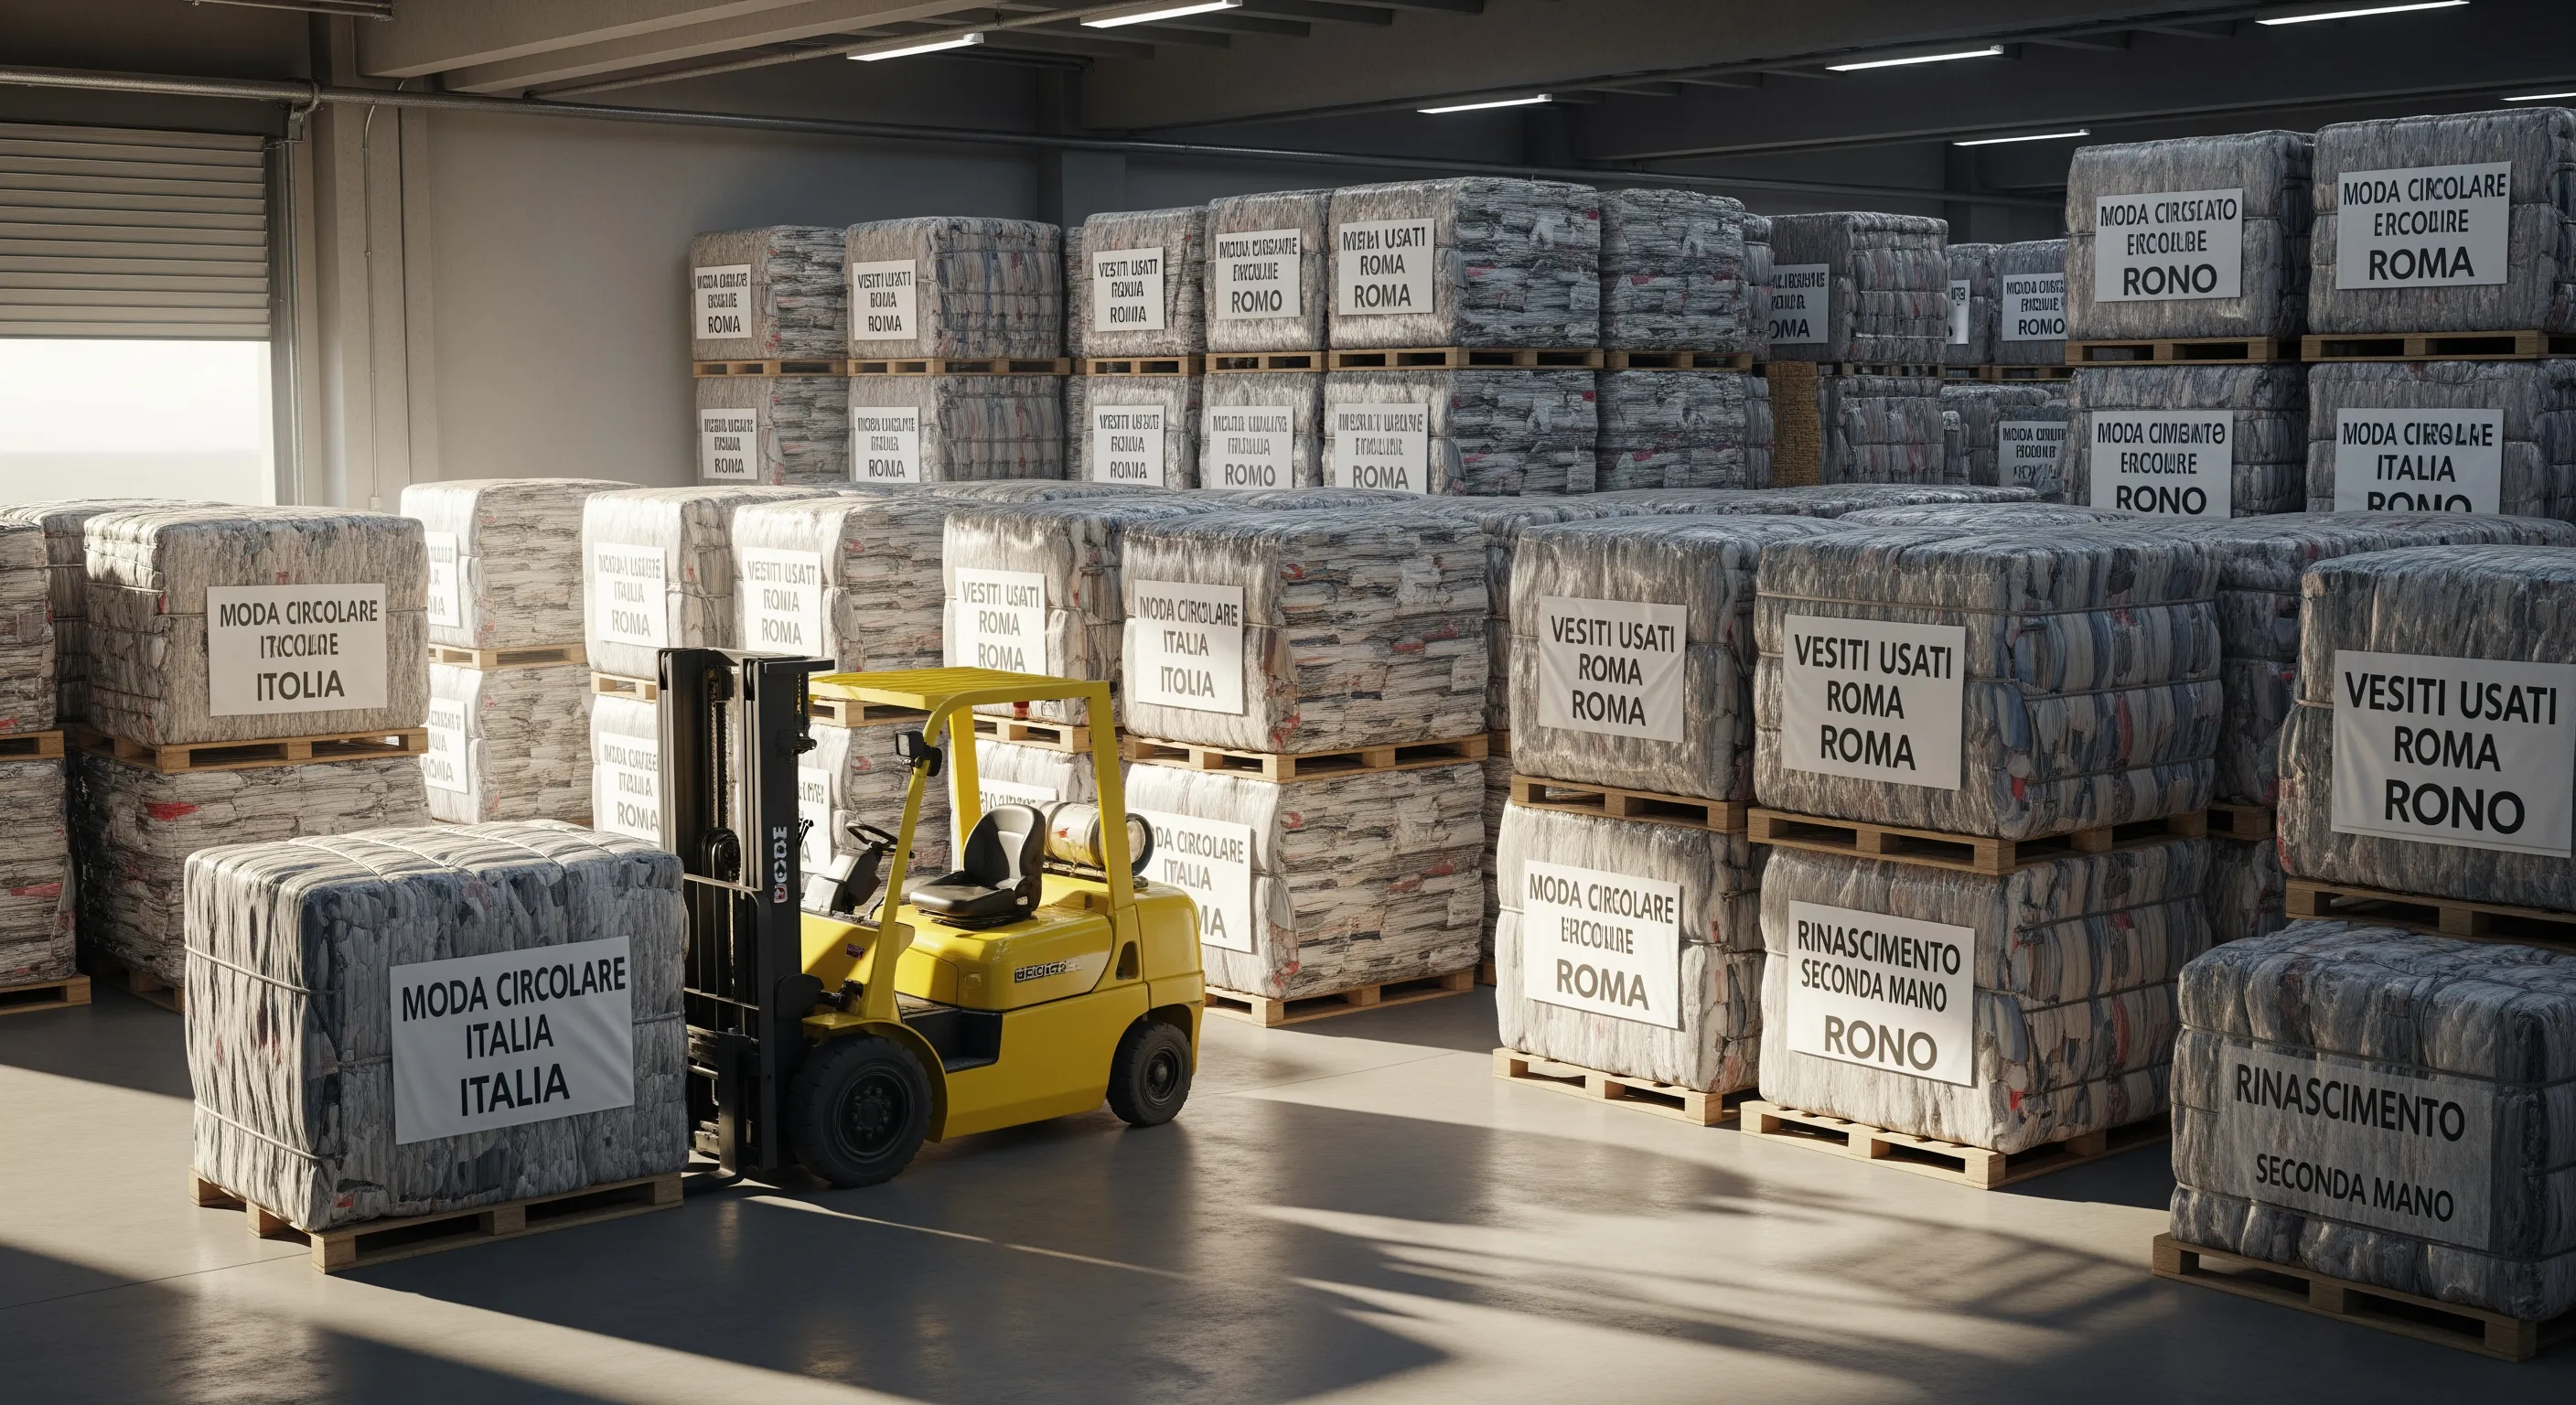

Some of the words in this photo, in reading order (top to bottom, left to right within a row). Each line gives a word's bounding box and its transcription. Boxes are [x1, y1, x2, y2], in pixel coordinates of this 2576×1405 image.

[2344, 180, 2401, 206] MODA
[2408, 173, 2506, 201] CIRCOLARE
[2100, 203, 2150, 227] MODA
[1360, 254, 1405, 275] ROMA
[2123, 263, 2217, 296] RONO
[2368, 246, 2475, 281] ROMA
[1232, 290, 1283, 313] ROMO
[1354, 284, 1411, 308] ROMA
[1769, 319, 1810, 339] OMA
[2018, 318, 2065, 335] ROMO
[2098, 423, 2144, 444] MODA
[2342, 423, 2398, 445] MODA
[1225, 464, 1276, 487] ROMO
[1353, 466, 1410, 489] ROMA
[2377, 454, 2456, 482] ITALIA
[2116, 485, 2207, 515] RONO
[1006, 584, 1039, 608] USATI
[220, 602, 281, 627] MODA
[285, 599, 378, 625] CIRCOLARE
[979, 610, 1021, 636] ROMA
[762, 617, 802, 646] ROMA
[1164, 629, 1209, 656] ITALIA
[1551, 616, 1612, 647] VESITI
[1619, 621, 1674, 652] USATI
[978, 642, 1025, 668] ROMA
[1579, 653, 1643, 686] ROMA
[1794, 634, 1869, 671] VESITI
[1880, 641, 1951, 679] USATI
[257, 670, 345, 702] ITOLIA
[1161, 666, 1215, 698] ITOLIA
[2345, 671, 2446, 716] VESITI
[2460, 681, 2557, 725] USATI
[1572, 690, 1646, 726] ROMA
[1827, 680, 1905, 719] ROMA
[1820, 724, 1916, 771] ROMA
[2394, 725, 2502, 772] ROMA
[617, 801, 659, 832] ROMA
[2385, 778, 2525, 835] RONO
[1155, 826, 1174, 852] DA
[1176, 831, 1244, 863] CIRCOLARE
[1164, 858, 1212, 892] ITALIA
[1530, 873, 1582, 908] MODA
[1588, 884, 1674, 925] CIRCOLARE
[1199, 905, 1227, 939] MA
[1798, 919, 1960, 975] RINASCIMENTO
[402, 976, 488, 1022] MODA
[497, 956, 626, 1007] CIRCOLARE
[1557, 958, 1649, 1011] ROMA
[1801, 958, 1884, 1002] SECONDA
[1889, 974, 1947, 1013] MANO
[467, 1014, 554, 1059] ITALIA
[1824, 1014, 1937, 1071] RONO
[460, 1063, 571, 1117] ITALIA
[2237, 1063, 2465, 1142] RINASCIMENTO
[2256, 1153, 2367, 1206] SECONDA
[2373, 1176, 2454, 1222] MANO
